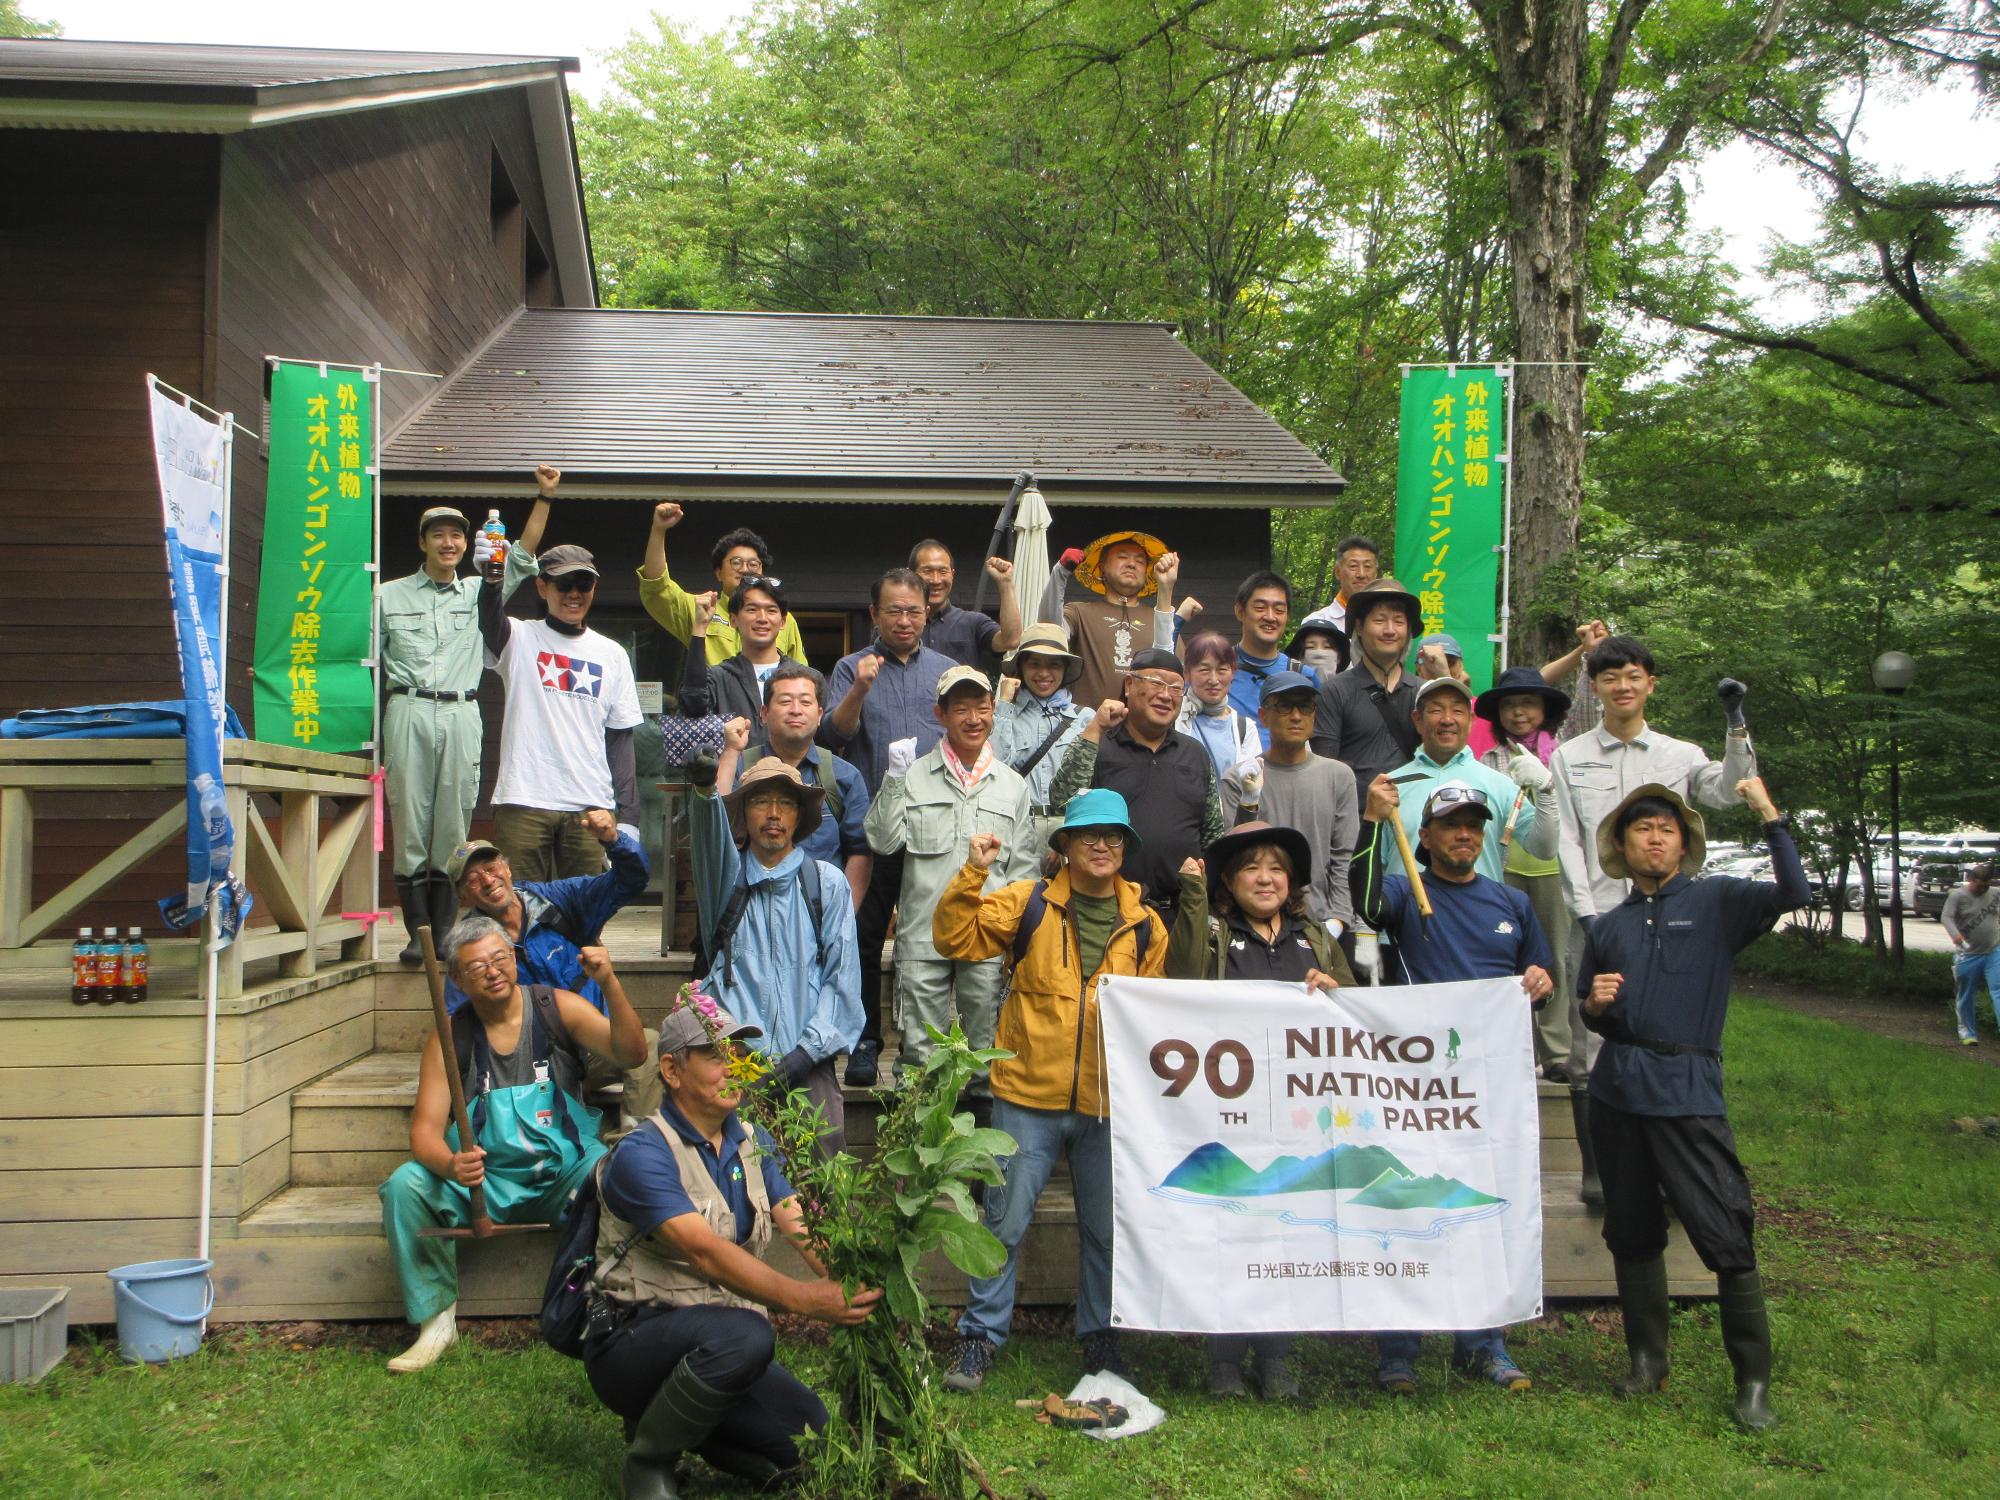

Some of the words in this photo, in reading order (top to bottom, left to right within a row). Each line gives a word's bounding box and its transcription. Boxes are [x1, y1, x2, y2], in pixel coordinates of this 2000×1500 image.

[336, 384, 362, 499] 外来植物
[1463, 381, 1489, 487] 外来植物
[288, 393, 330, 744] オオハンゴンソウ除去作業中
[1149, 1038, 1255, 1099] 90
[1285, 1026, 1435, 1064] NIKKO
[1286, 1071, 1477, 1101] NATIONAL
[1219, 1111, 1248, 1124] TH
[1383, 1105, 1482, 1131] PARK
